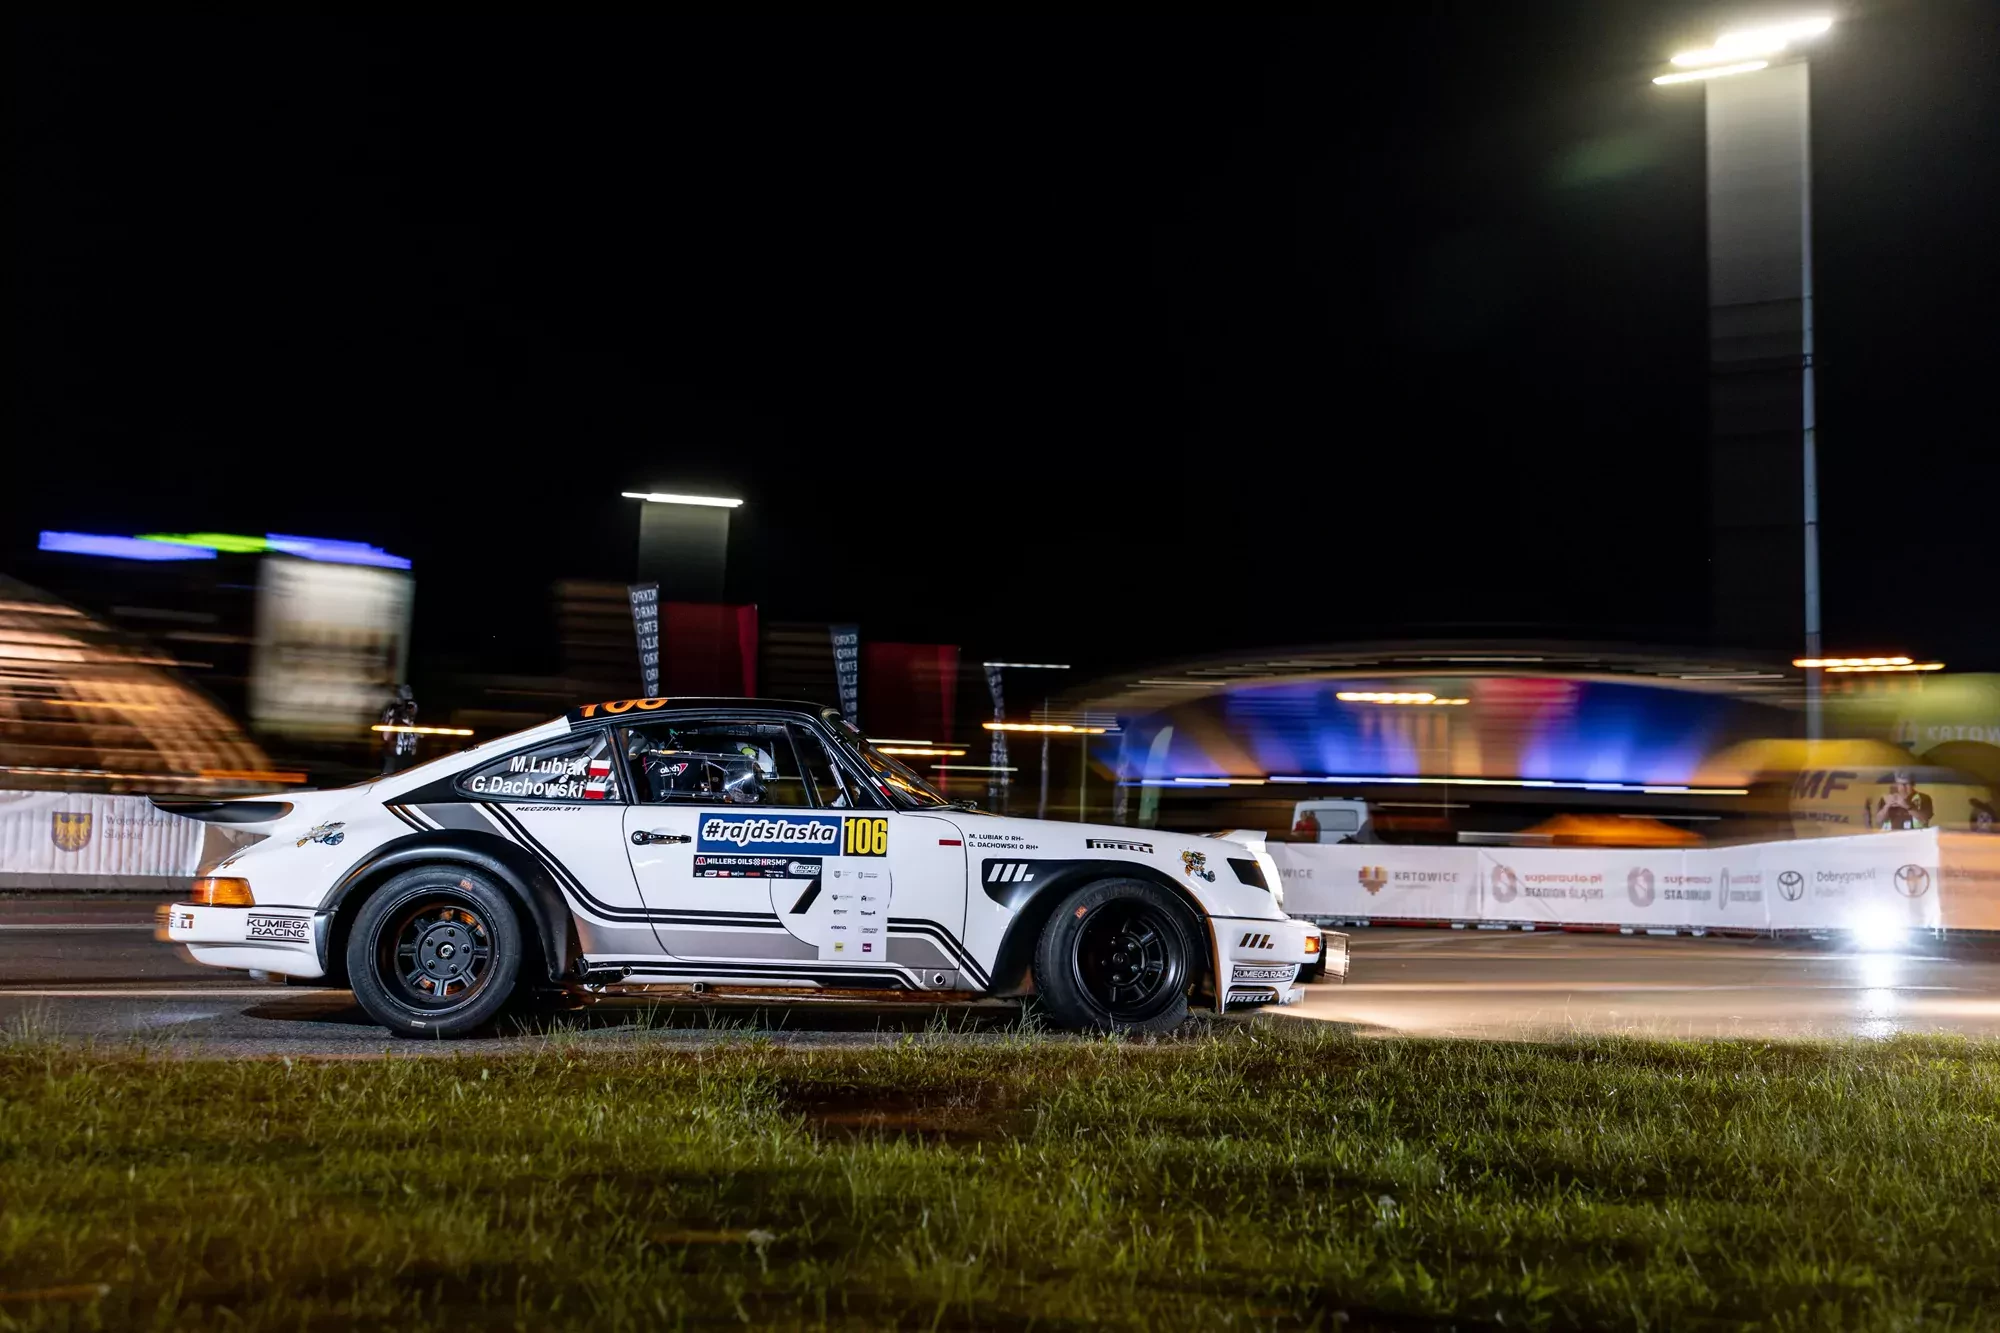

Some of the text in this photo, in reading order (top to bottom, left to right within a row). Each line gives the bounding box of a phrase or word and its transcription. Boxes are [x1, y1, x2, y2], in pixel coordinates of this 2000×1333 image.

[510, 755, 587, 776] M.Lubiak
[471, 775, 586, 798] G.Dachowski
[704, 821, 835, 844] #rajdslaska
[844, 818, 888, 855] 106
[977, 842, 1018, 850] DACHOWSKI
[1086, 838, 1153, 854] PIRELLI
[706, 857, 737, 865] MILLERS
[761, 858, 787, 866] HRSMP
[1280, 868, 1313, 880] WICE
[1394, 871, 1460, 884] KATOWICE
[246, 918, 310, 931] KUMIEGA
[251, 927, 306, 938] RACING
